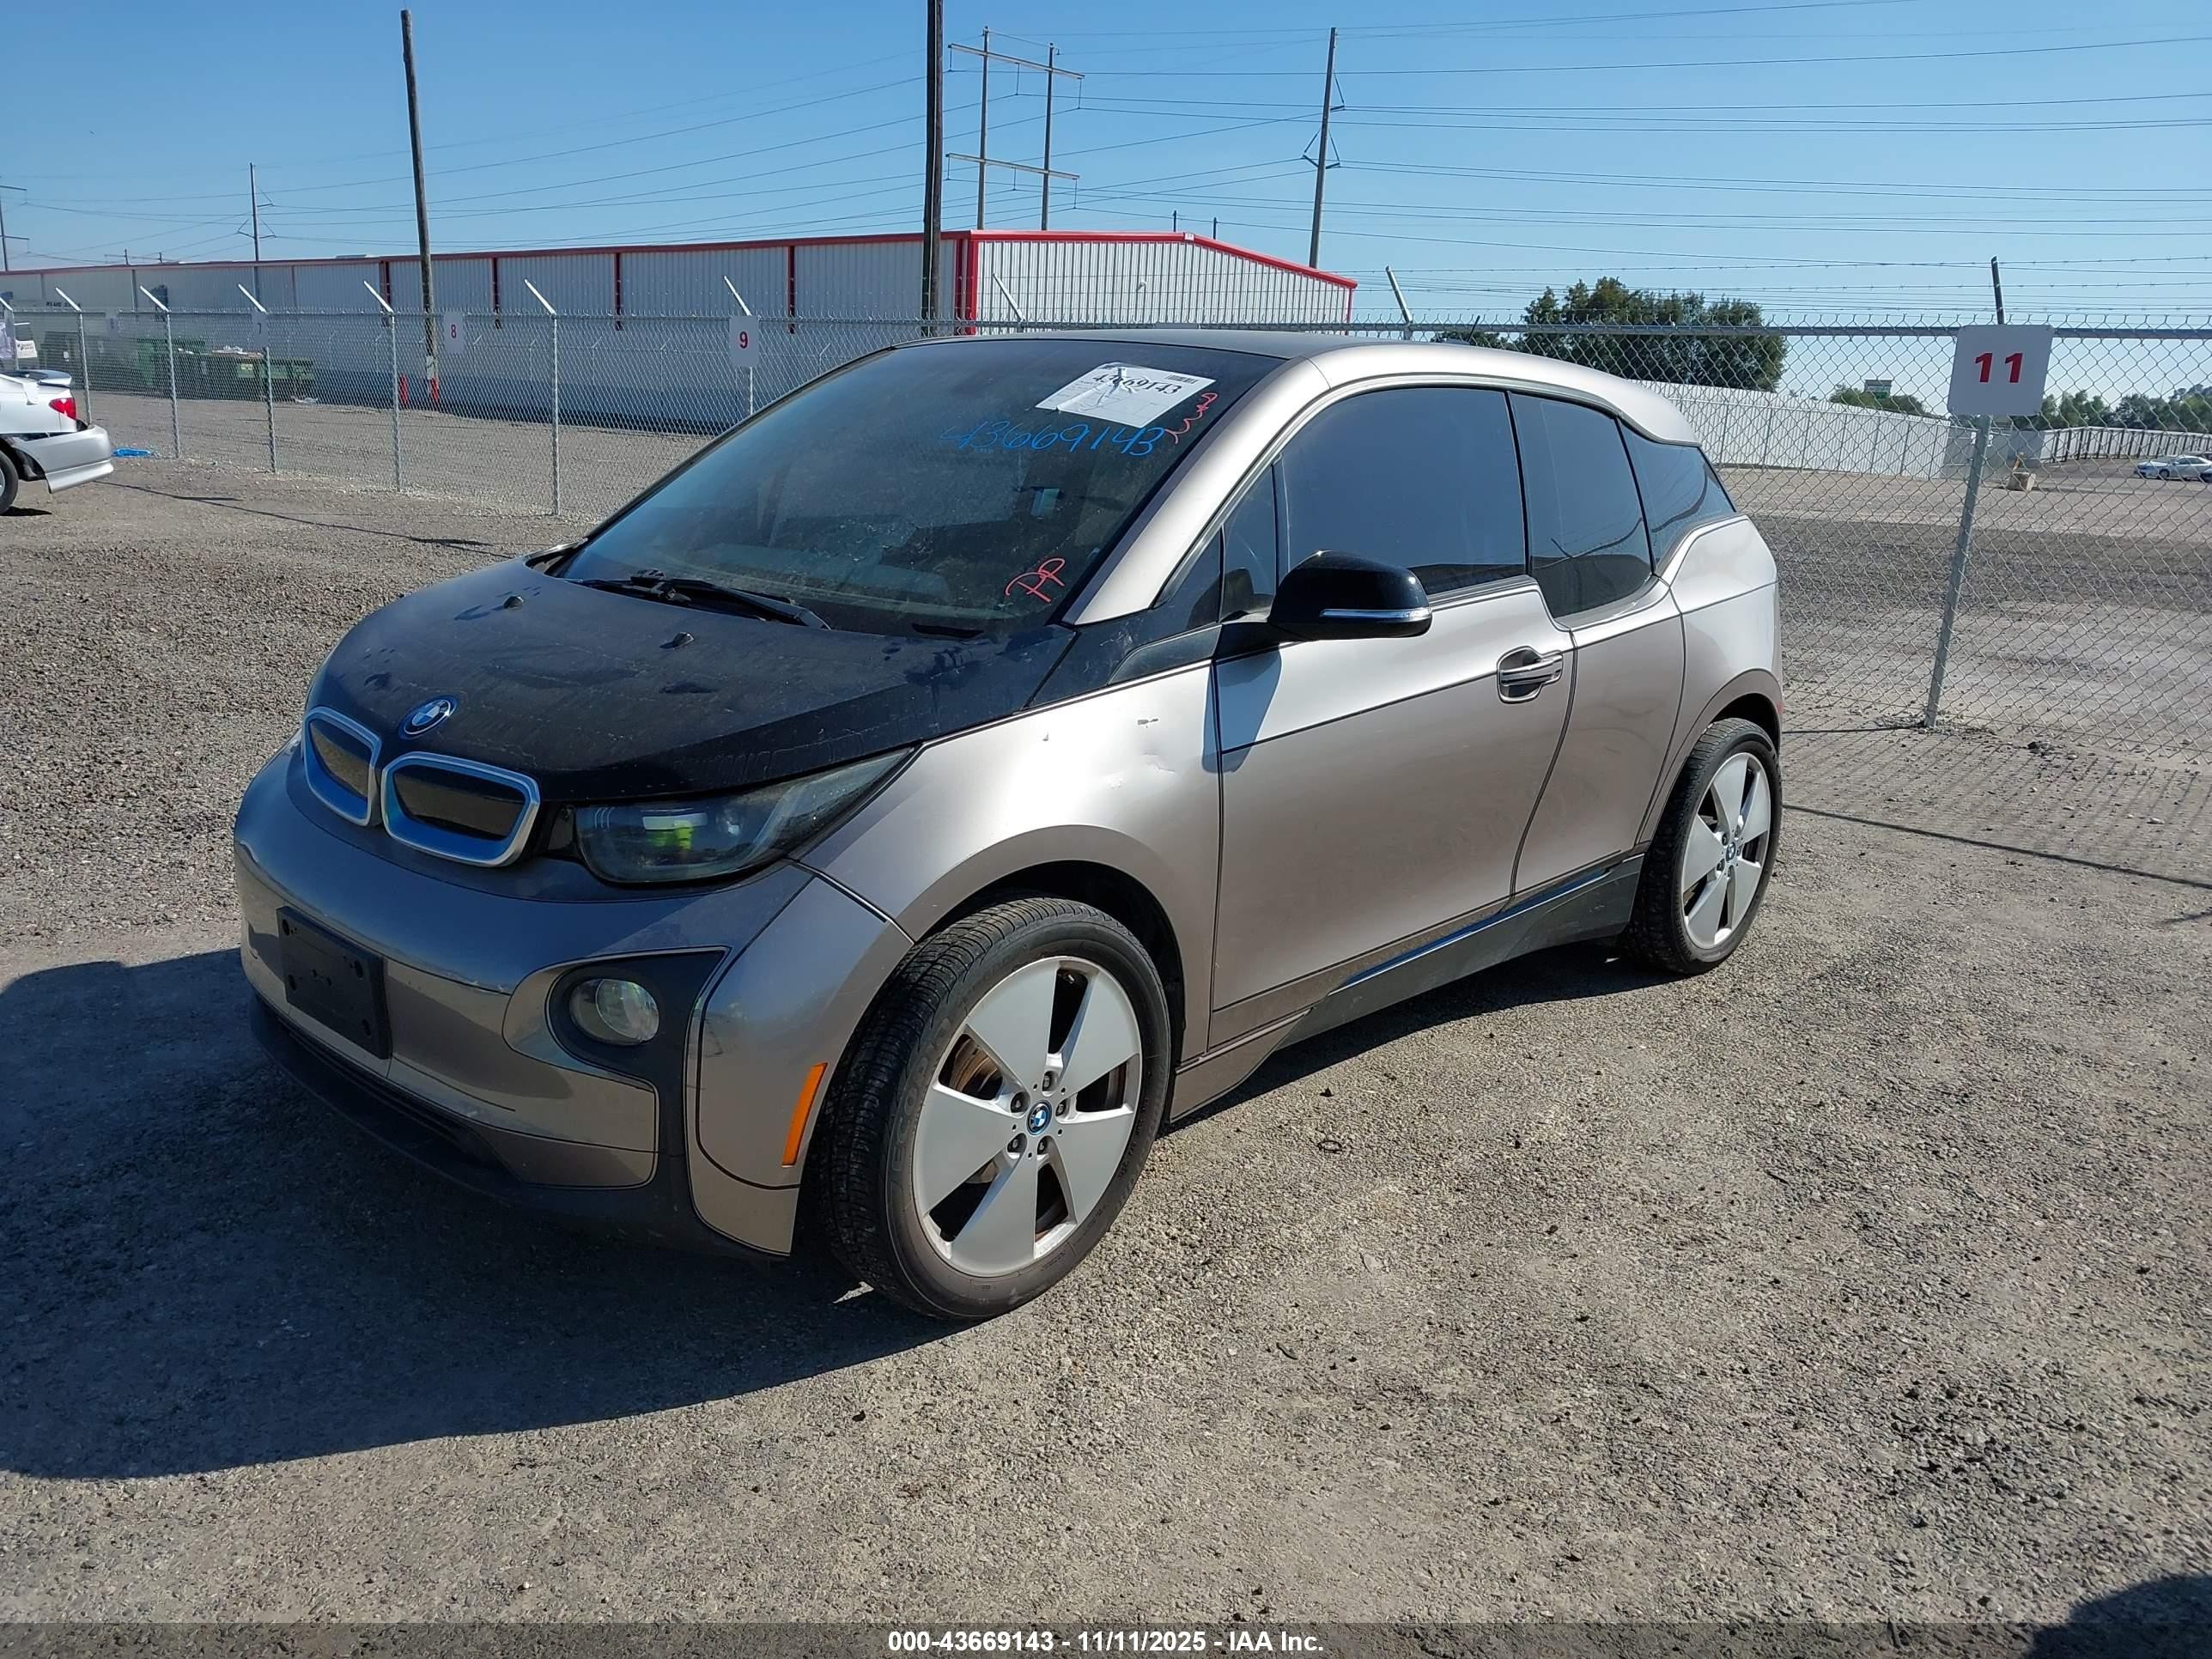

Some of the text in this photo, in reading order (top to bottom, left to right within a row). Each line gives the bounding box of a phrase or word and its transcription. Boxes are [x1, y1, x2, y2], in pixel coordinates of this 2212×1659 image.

[451, 324, 457, 338] 8
[739, 331, 748, 349] 9
[1975, 352, 2023, 383] 11
[939, 421, 1164, 456] 43669143
